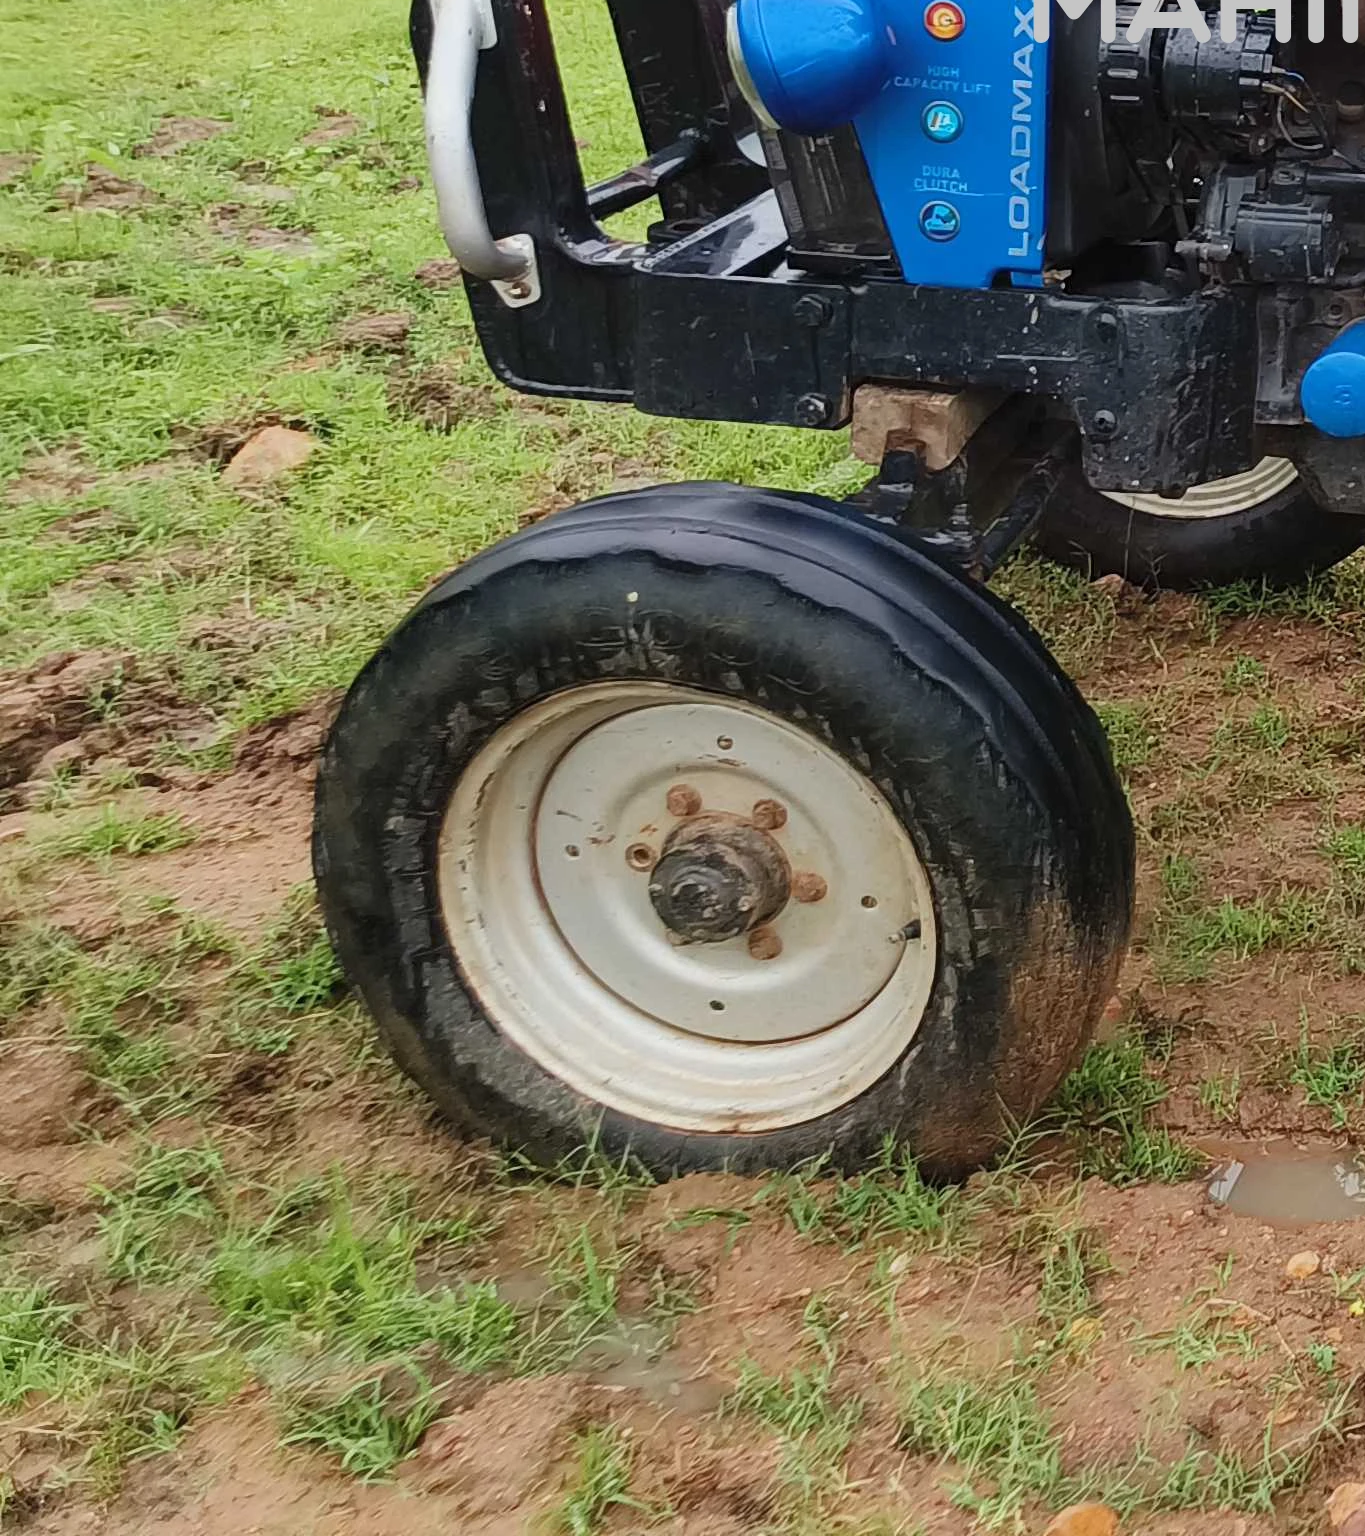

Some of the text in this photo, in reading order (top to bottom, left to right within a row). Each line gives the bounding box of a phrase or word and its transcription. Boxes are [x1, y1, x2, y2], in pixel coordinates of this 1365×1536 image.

[893, 76, 992, 95] CAPACITY LIFT
[921, 165, 960, 179] DURA
[913, 177, 968, 192] CLUTCH
